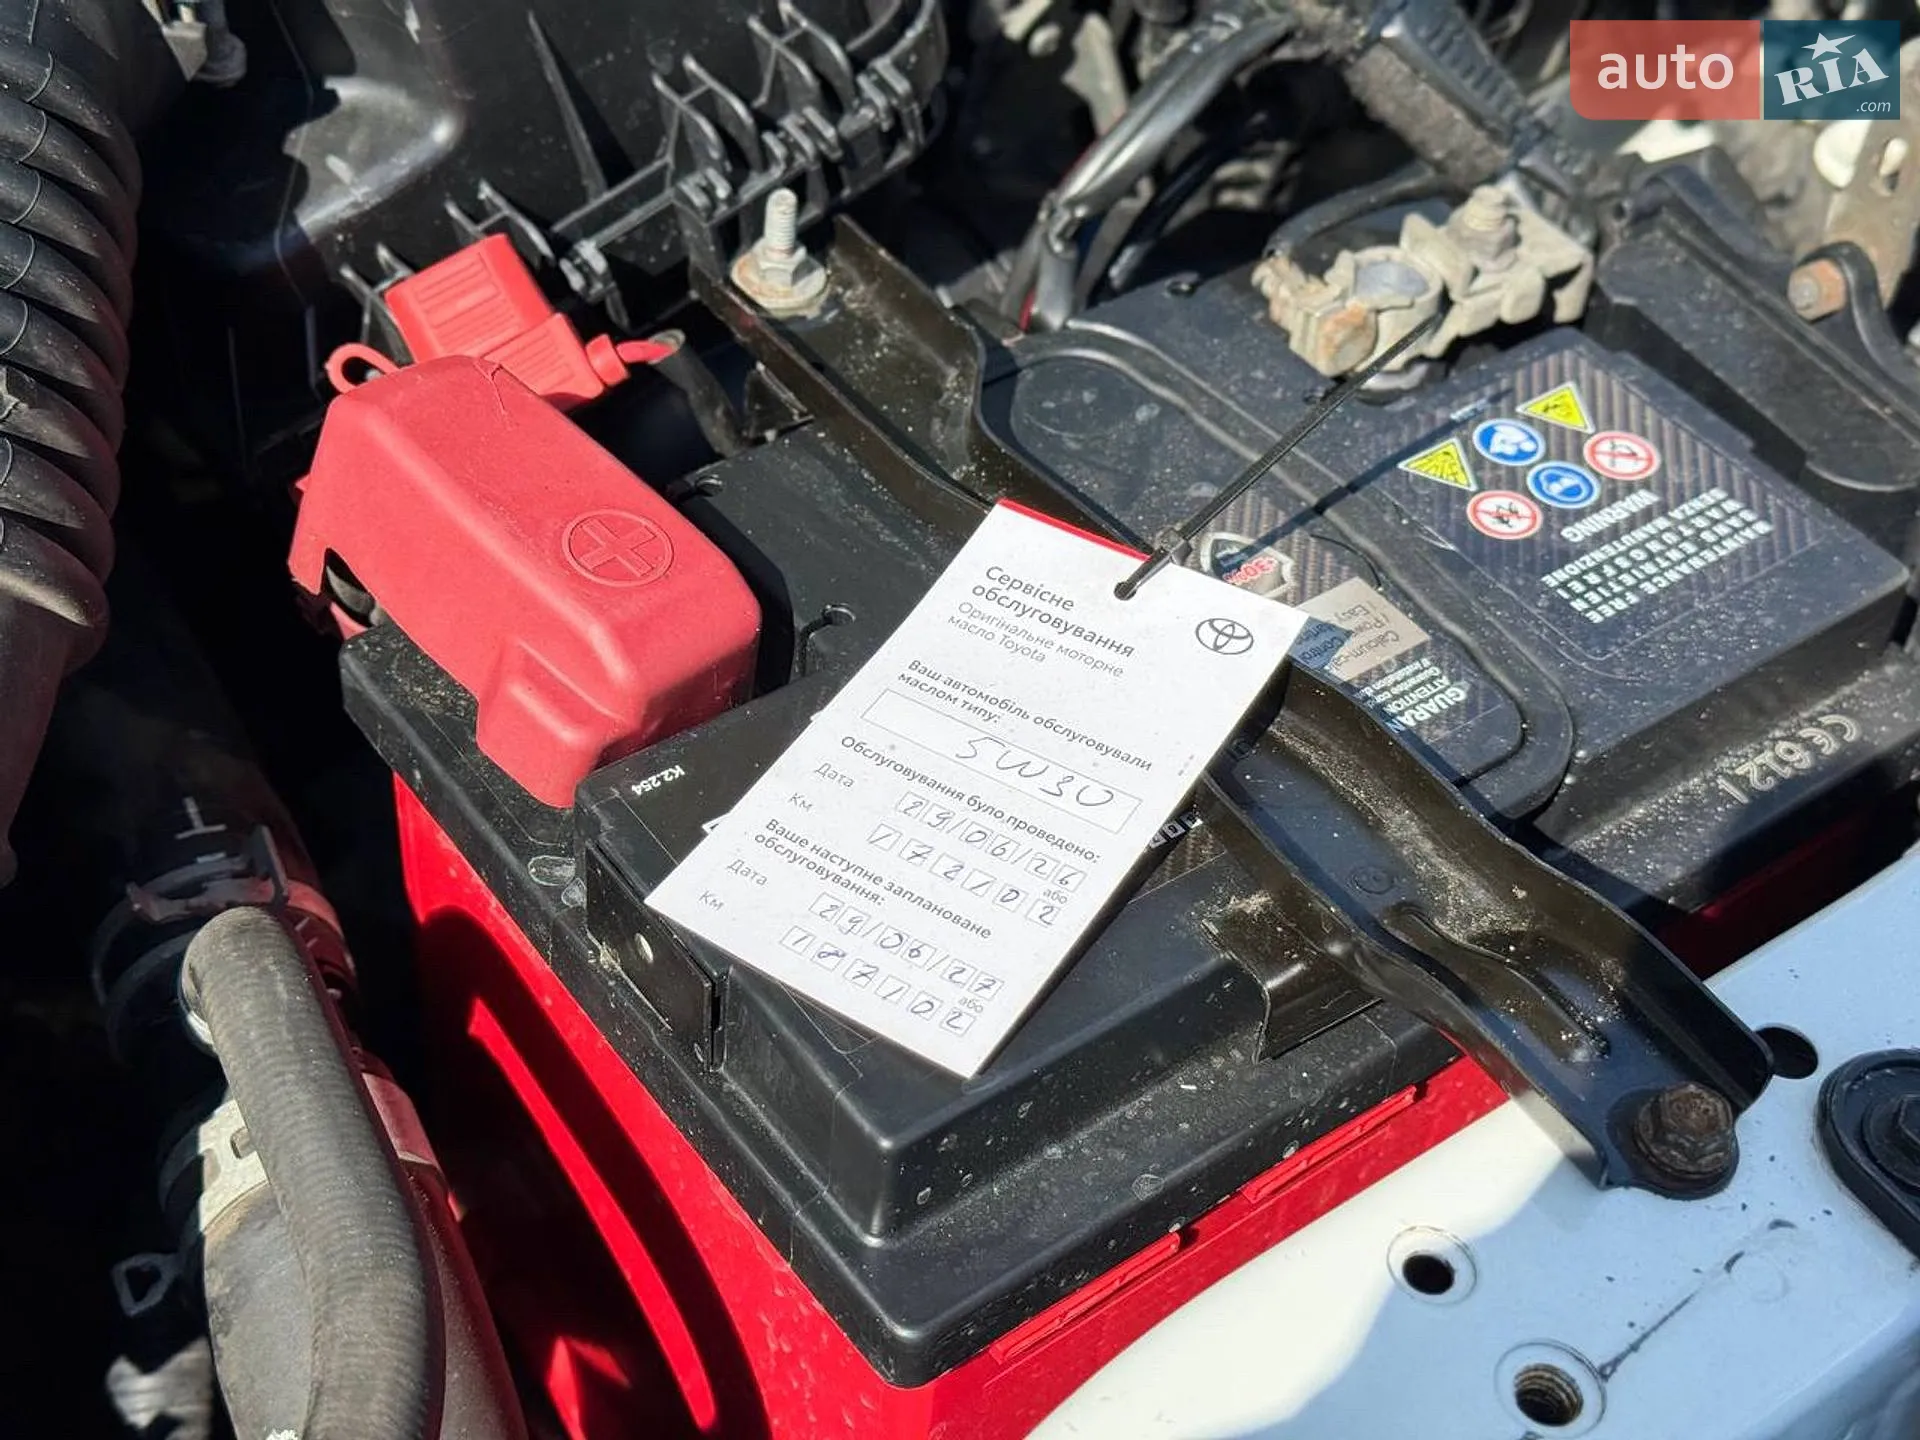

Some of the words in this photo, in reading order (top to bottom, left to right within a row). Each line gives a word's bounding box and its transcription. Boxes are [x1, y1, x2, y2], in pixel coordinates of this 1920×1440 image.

[1560, 488, 1661, 544] WARNING
[1541, 517, 1670, 589] MANUTENZIONE
[1639, 519, 1775, 596] MAINTENANCE
[986, 564, 1075, 612] Сервісне
[1585, 593, 1640, 624] FREE
[947, 615, 997, 646] масло
[998, 632, 1047, 664] Toyota
[958, 600, 1055, 648] Оригінальне
[1056, 644, 1125, 679] моторне
[972, 583, 1136, 657] обслуговування
[897, 672, 958, 705] маслом
[959, 697, 1003, 725] типу:
[907, 660, 944, 683] Ваш
[944, 674, 1029, 722] автомобіль
[1033, 713, 1153, 772] обслуговували
[631, 764, 685, 796] K2.254
[814, 762, 856, 789] Дата
[841, 735, 964, 802] Обслуговування
[966, 794, 1005, 824] було
[1006, 810, 1103, 865] проведено:
[788, 791, 813, 813] Км
[725, 858, 769, 887] Дата
[754, 832, 885, 906] обслуговування:
[765, 817, 809, 850] Ваше
[810, 841, 884, 887] наступне
[884, 877, 993, 940] заплановане
[698, 890, 725, 911] Км
[1042, 888, 1069, 905] або
[959, 997, 985, 1015] або
